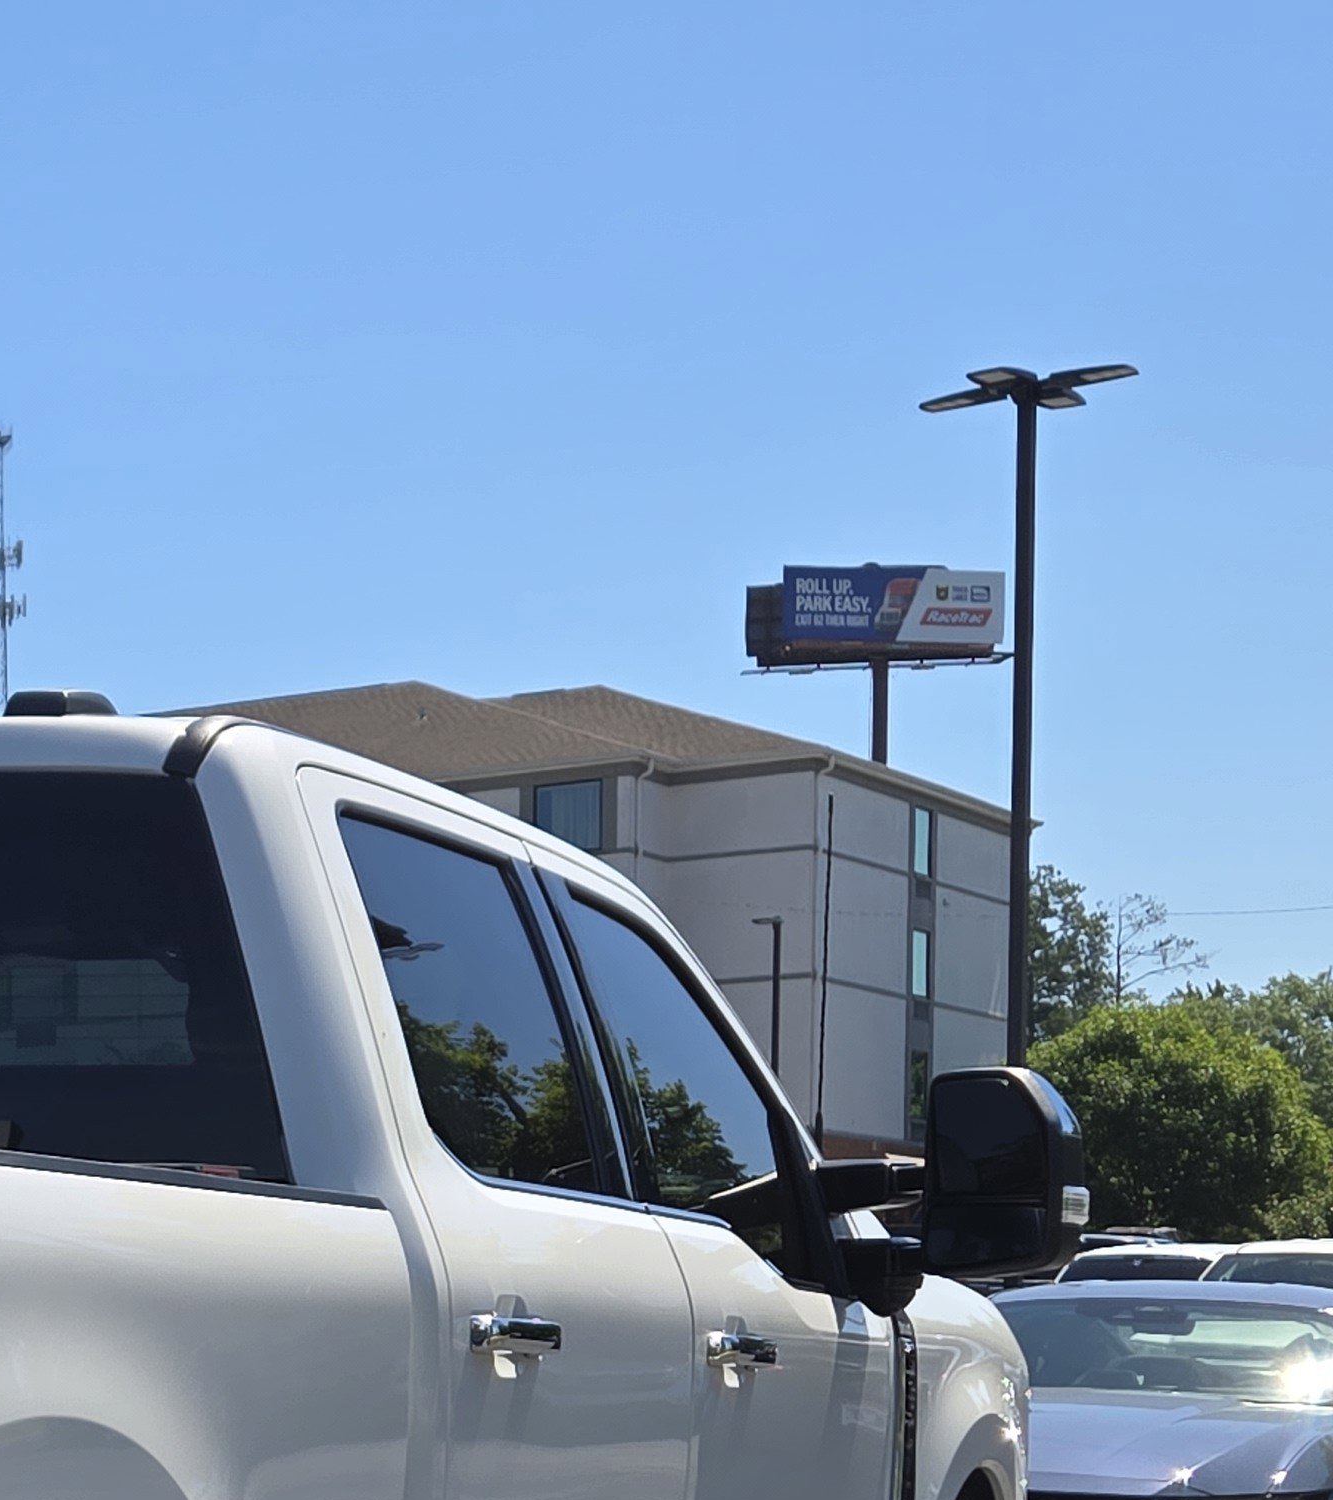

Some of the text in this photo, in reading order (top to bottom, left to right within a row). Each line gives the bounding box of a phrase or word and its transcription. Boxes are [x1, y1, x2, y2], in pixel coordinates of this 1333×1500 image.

[795, 577, 854, 596] ROLL UP.
[795, 594, 872, 613] PARK EASY.
